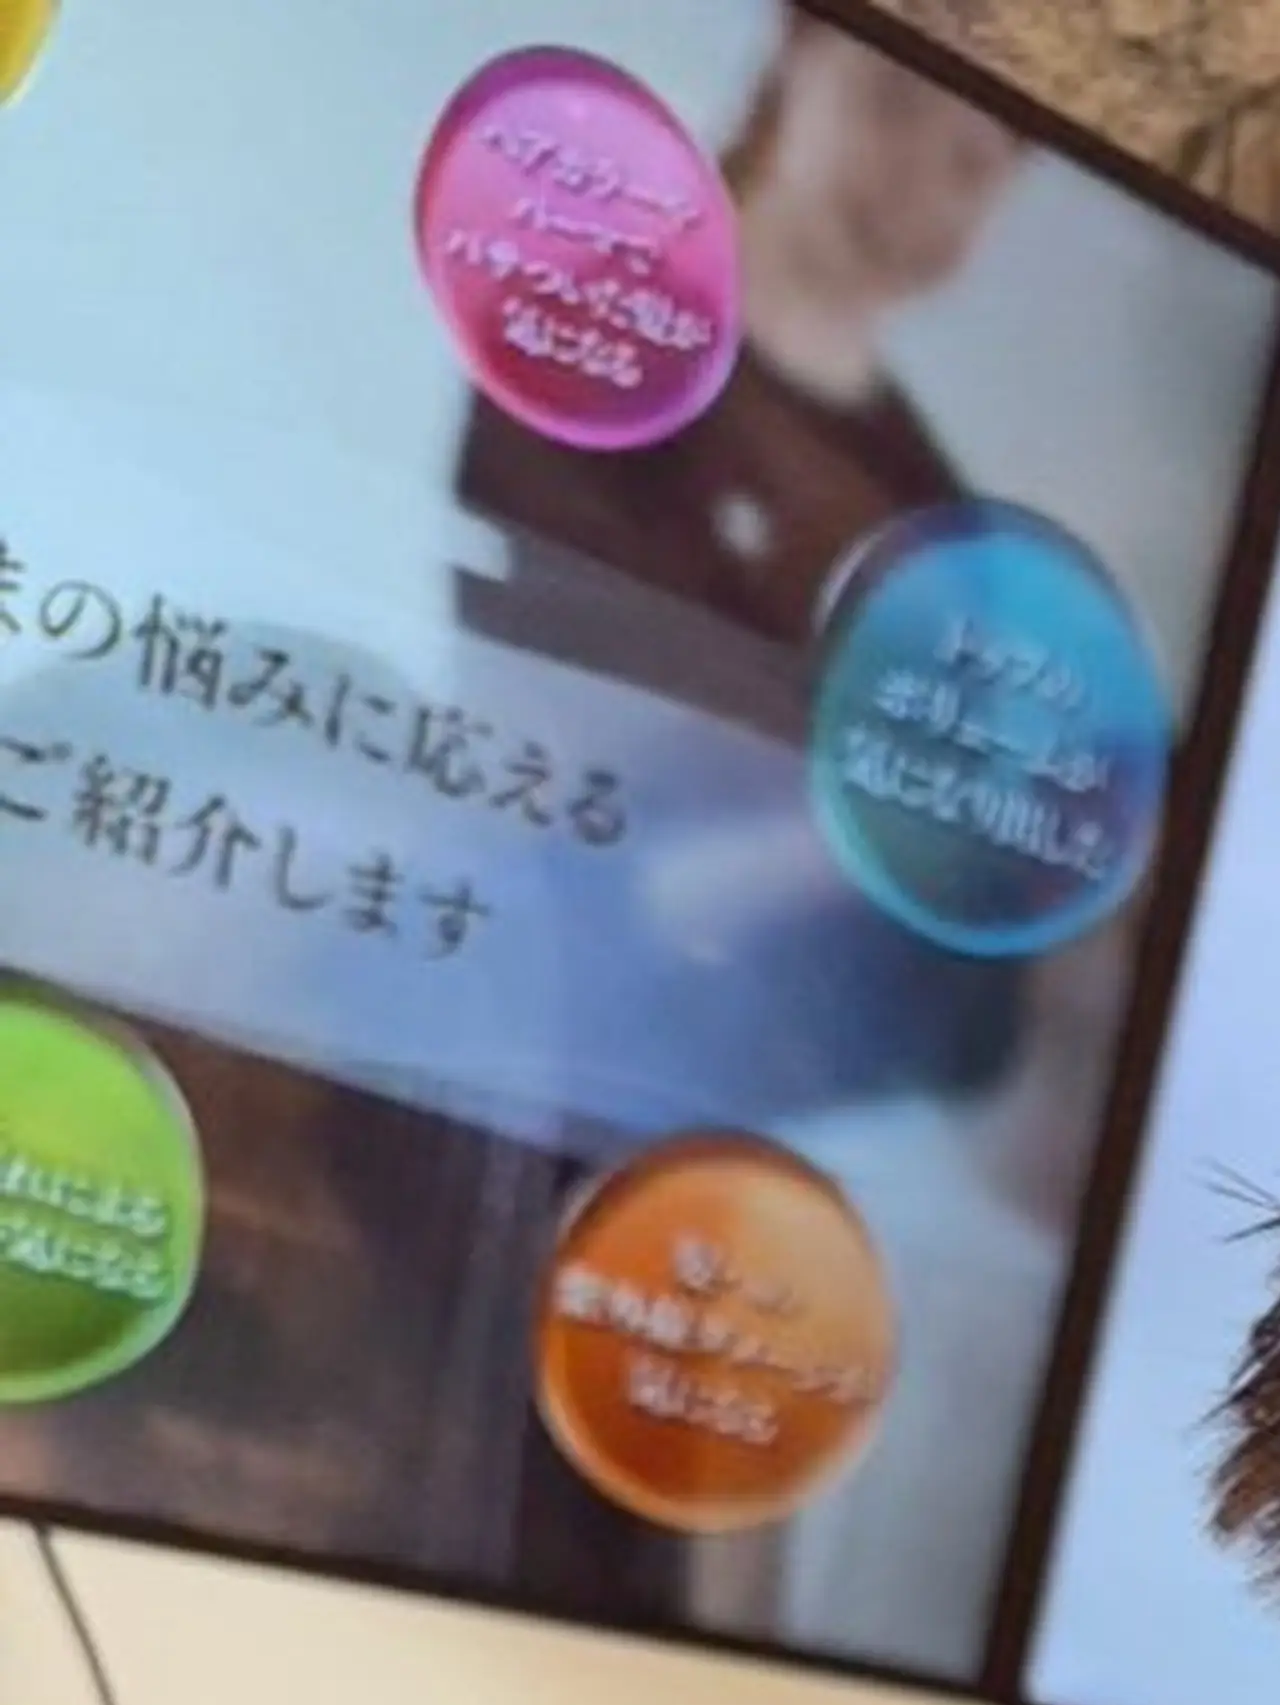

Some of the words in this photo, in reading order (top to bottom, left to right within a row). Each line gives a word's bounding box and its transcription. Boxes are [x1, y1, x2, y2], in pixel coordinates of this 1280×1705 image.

[0, 538, 627, 848] の悩みに応える
[0, 735, 492, 961] ご紹介します
